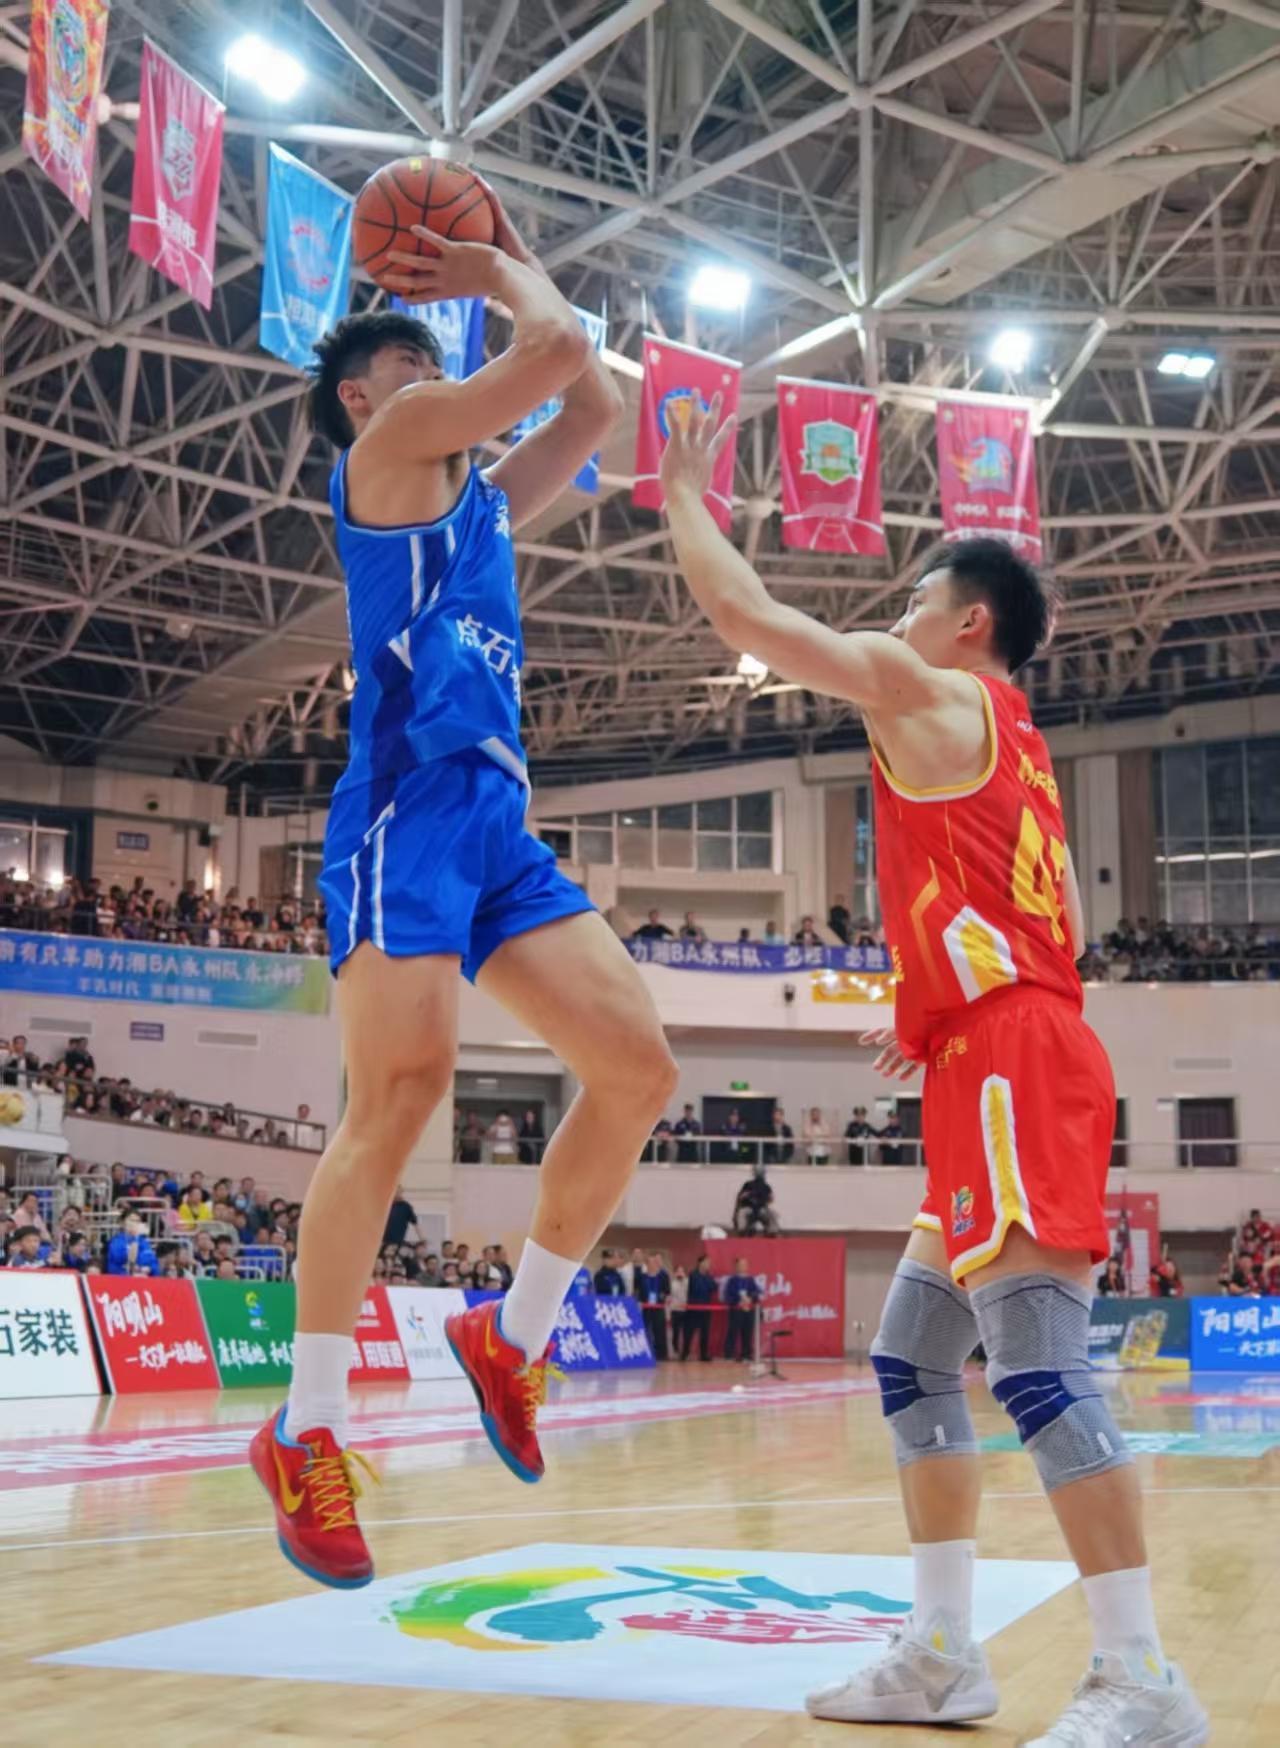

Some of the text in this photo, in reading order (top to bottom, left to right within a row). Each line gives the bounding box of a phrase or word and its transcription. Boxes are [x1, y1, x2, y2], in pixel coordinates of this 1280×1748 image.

[455, 613, 521, 706] 点石
[96, 1290, 163, 1337] 阳明山
